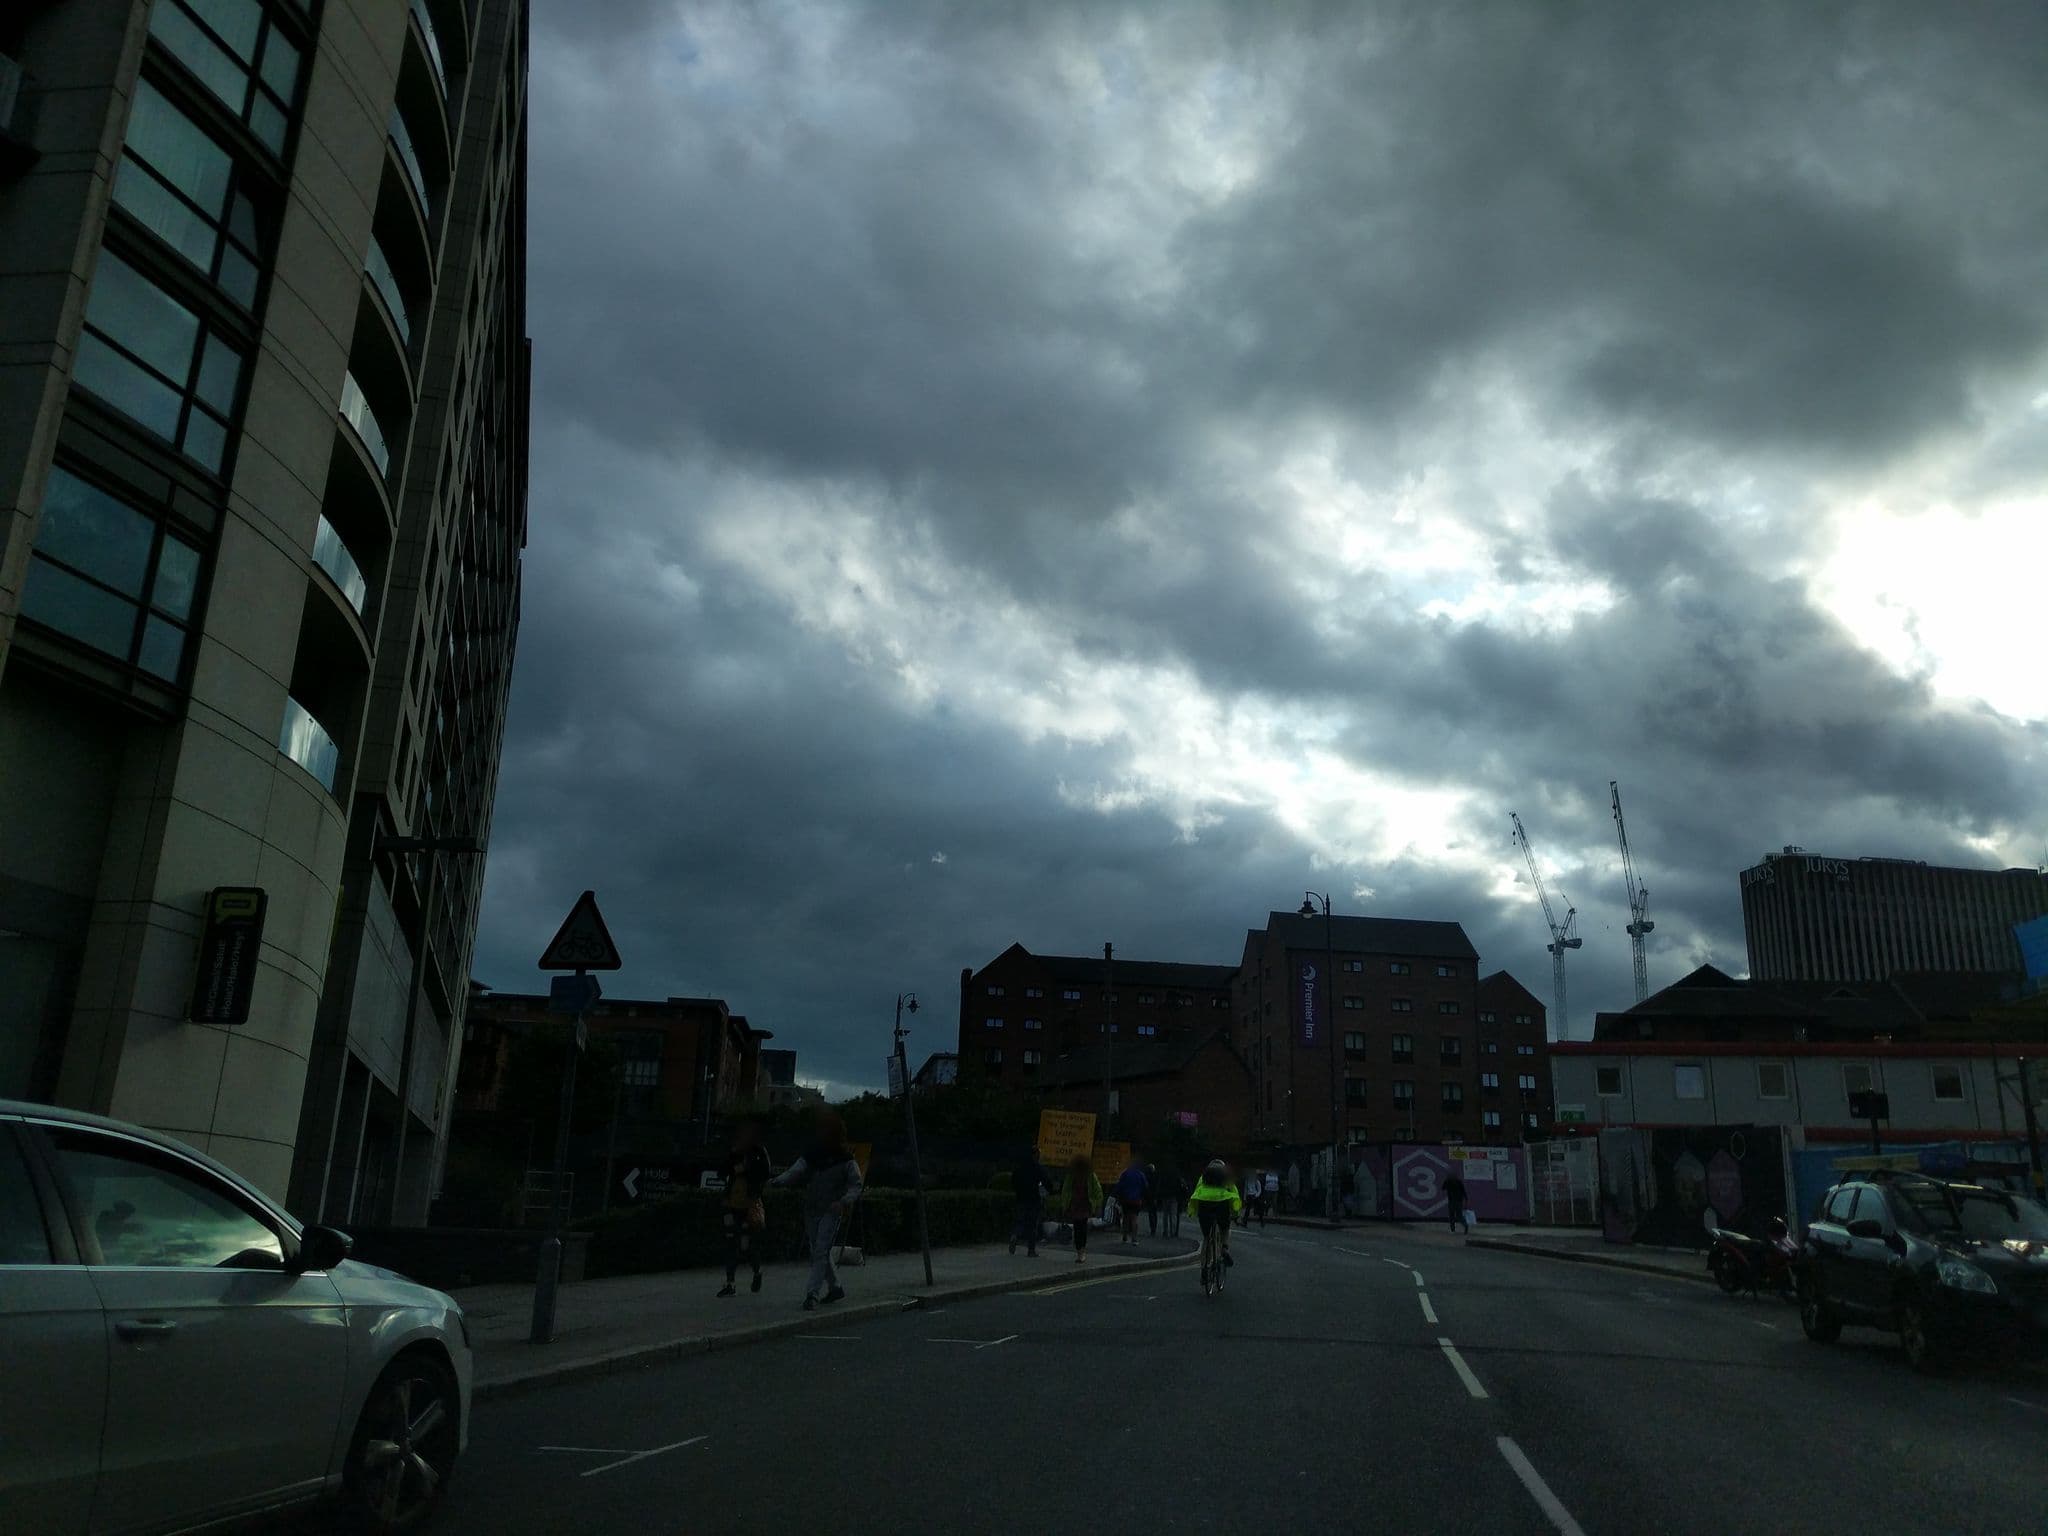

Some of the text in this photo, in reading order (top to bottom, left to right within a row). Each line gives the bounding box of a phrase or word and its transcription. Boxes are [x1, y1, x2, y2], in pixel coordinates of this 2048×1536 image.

[1745, 865, 1774, 888] JURYS
[1806, 857, 1849, 875] JURYS
[1304, 982, 1315, 1040] Premier Inn
[1407, 1165, 1438, 1201] 3
